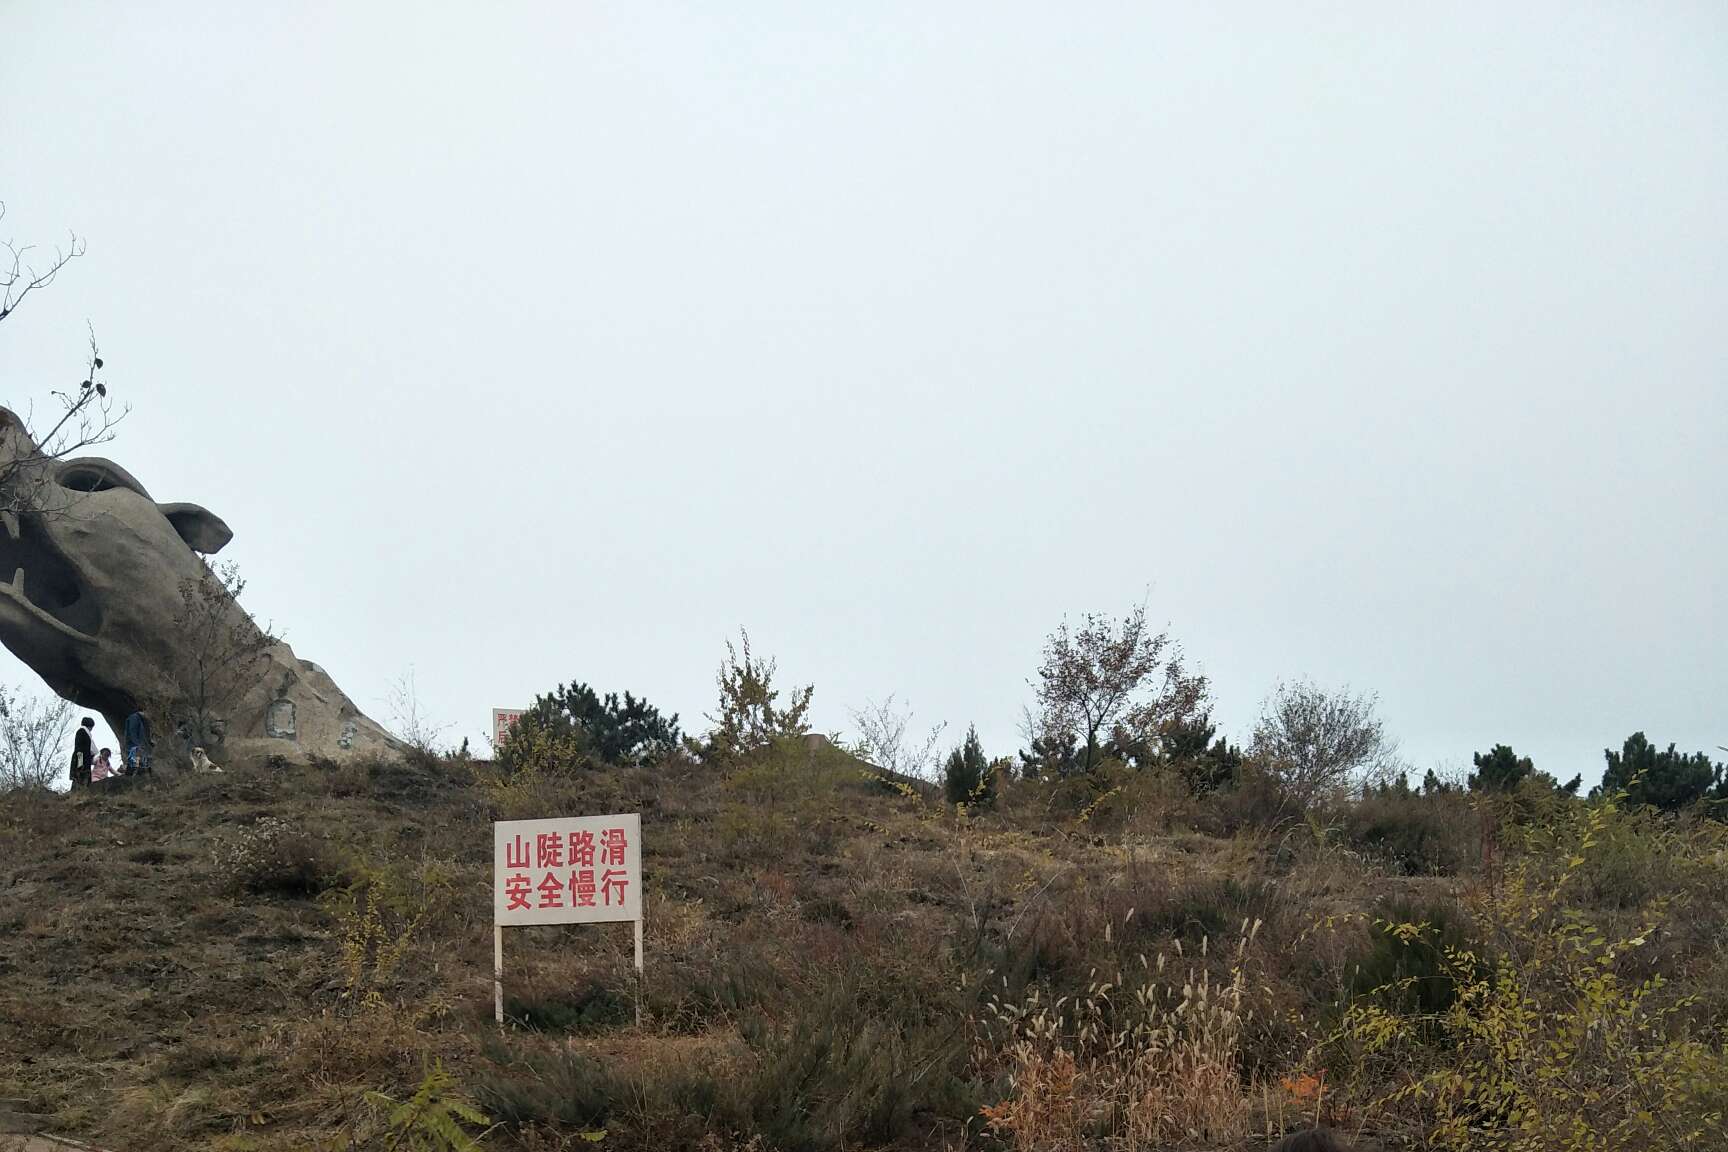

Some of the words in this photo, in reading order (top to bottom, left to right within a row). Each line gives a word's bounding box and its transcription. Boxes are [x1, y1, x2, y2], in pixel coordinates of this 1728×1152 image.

[506, 828, 628, 869] 山陡路滑
[505, 869, 629, 911] 安全慢行
